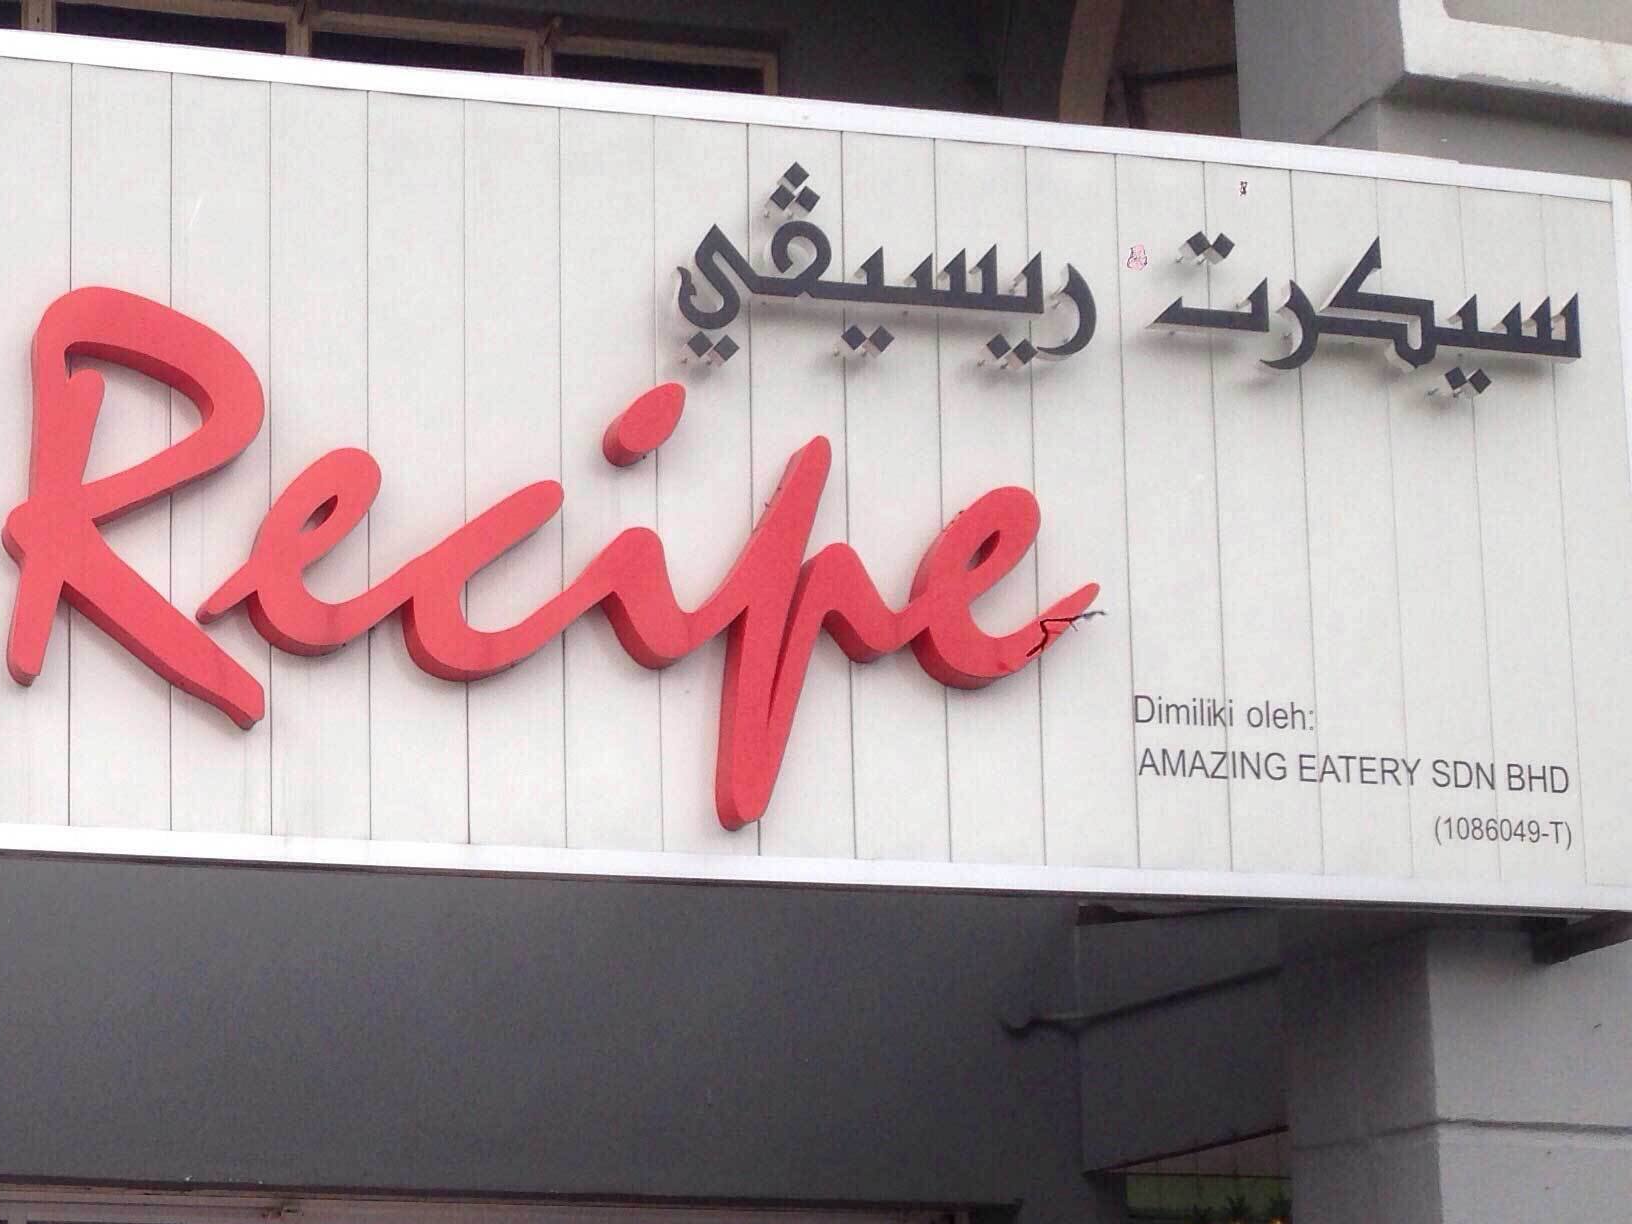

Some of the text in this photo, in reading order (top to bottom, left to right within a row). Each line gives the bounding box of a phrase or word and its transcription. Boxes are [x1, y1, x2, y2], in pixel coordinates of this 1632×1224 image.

[1154, 232, 1583, 393] سيكرت
[3, 287, 1097, 829] Recipe
[1134, 695, 1315, 731] Dimiliki oleh:
[1139, 747, 1570, 794] AMAZING EATERY SDN BHD
[1434, 815, 1573, 850] (1086049-T)
